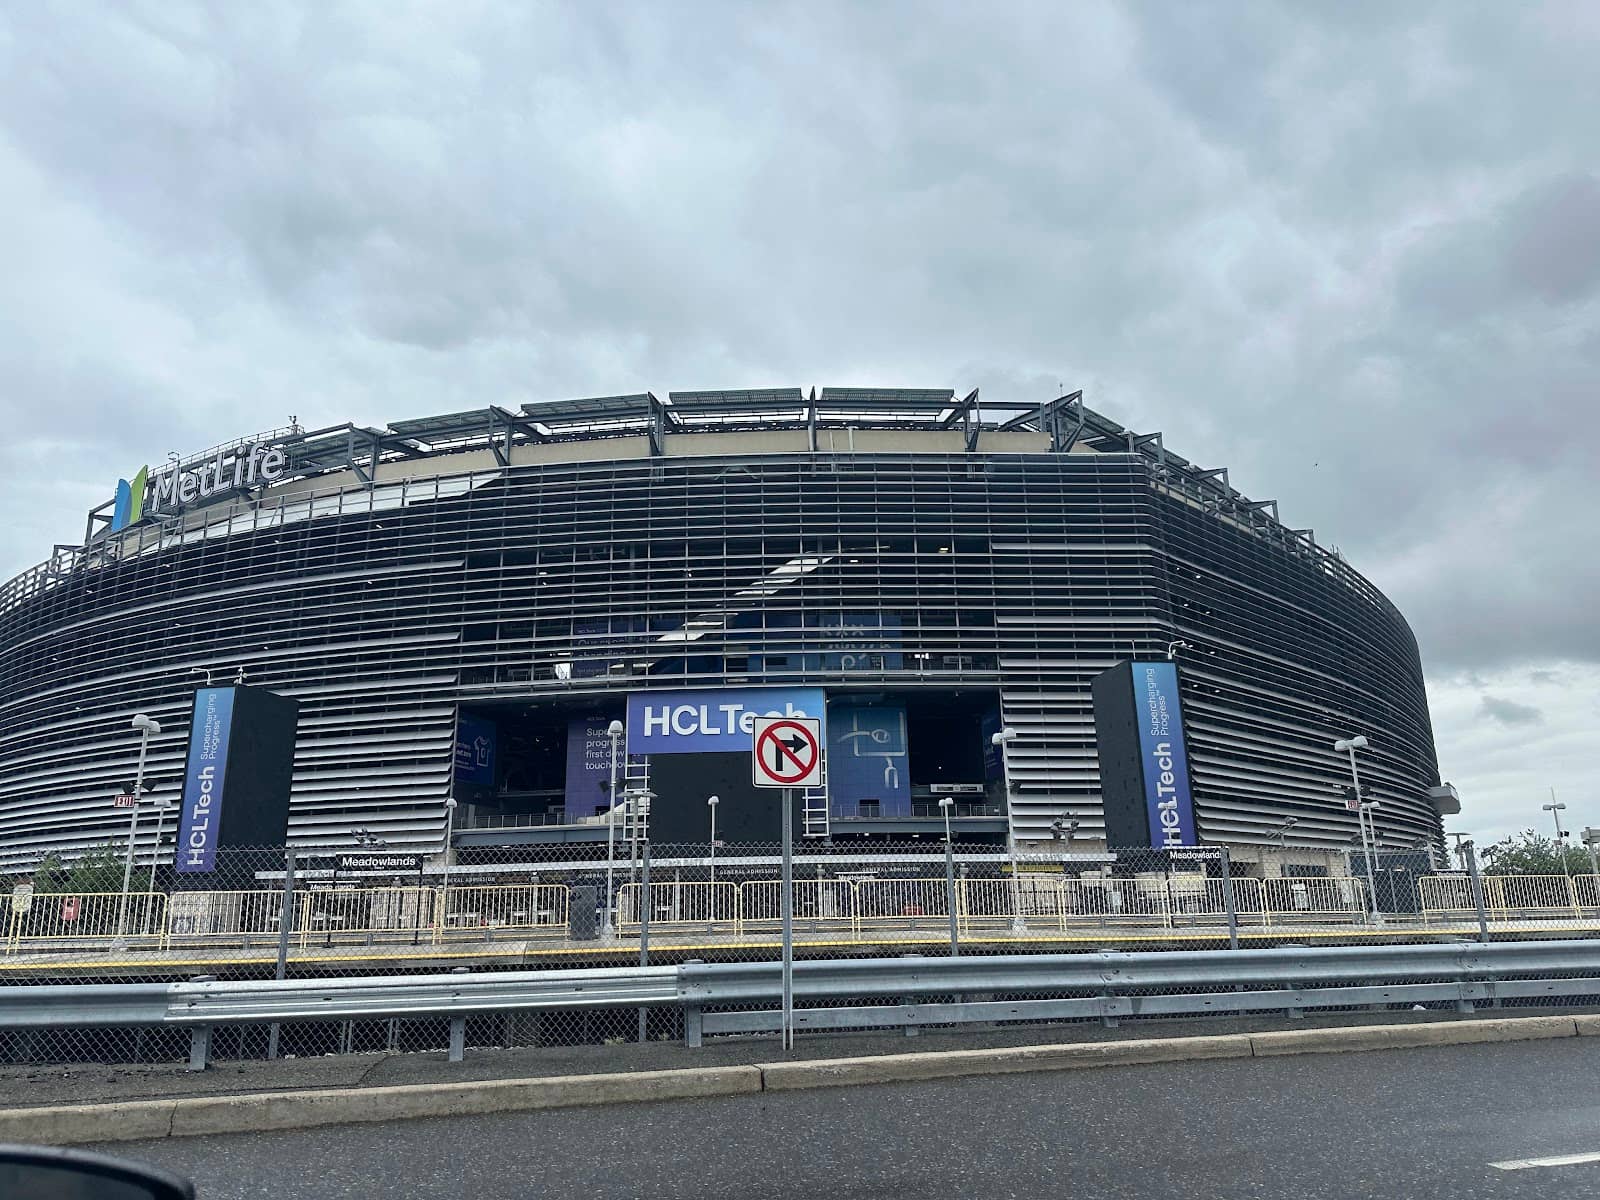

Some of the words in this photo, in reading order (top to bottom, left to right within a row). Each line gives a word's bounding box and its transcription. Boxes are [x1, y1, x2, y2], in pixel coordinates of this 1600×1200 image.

[151, 441, 286, 512] MetLife
[200, 693, 217, 760] Supercharging
[1146, 668, 1160, 736] Supercharging
[586, 738, 625, 749] progrss
[586, 749, 604, 759] first
[187, 765, 215, 866] HCLTech
[1153, 742, 1183, 846] HCLTech
[342, 856, 416, 866] Meadowlands
